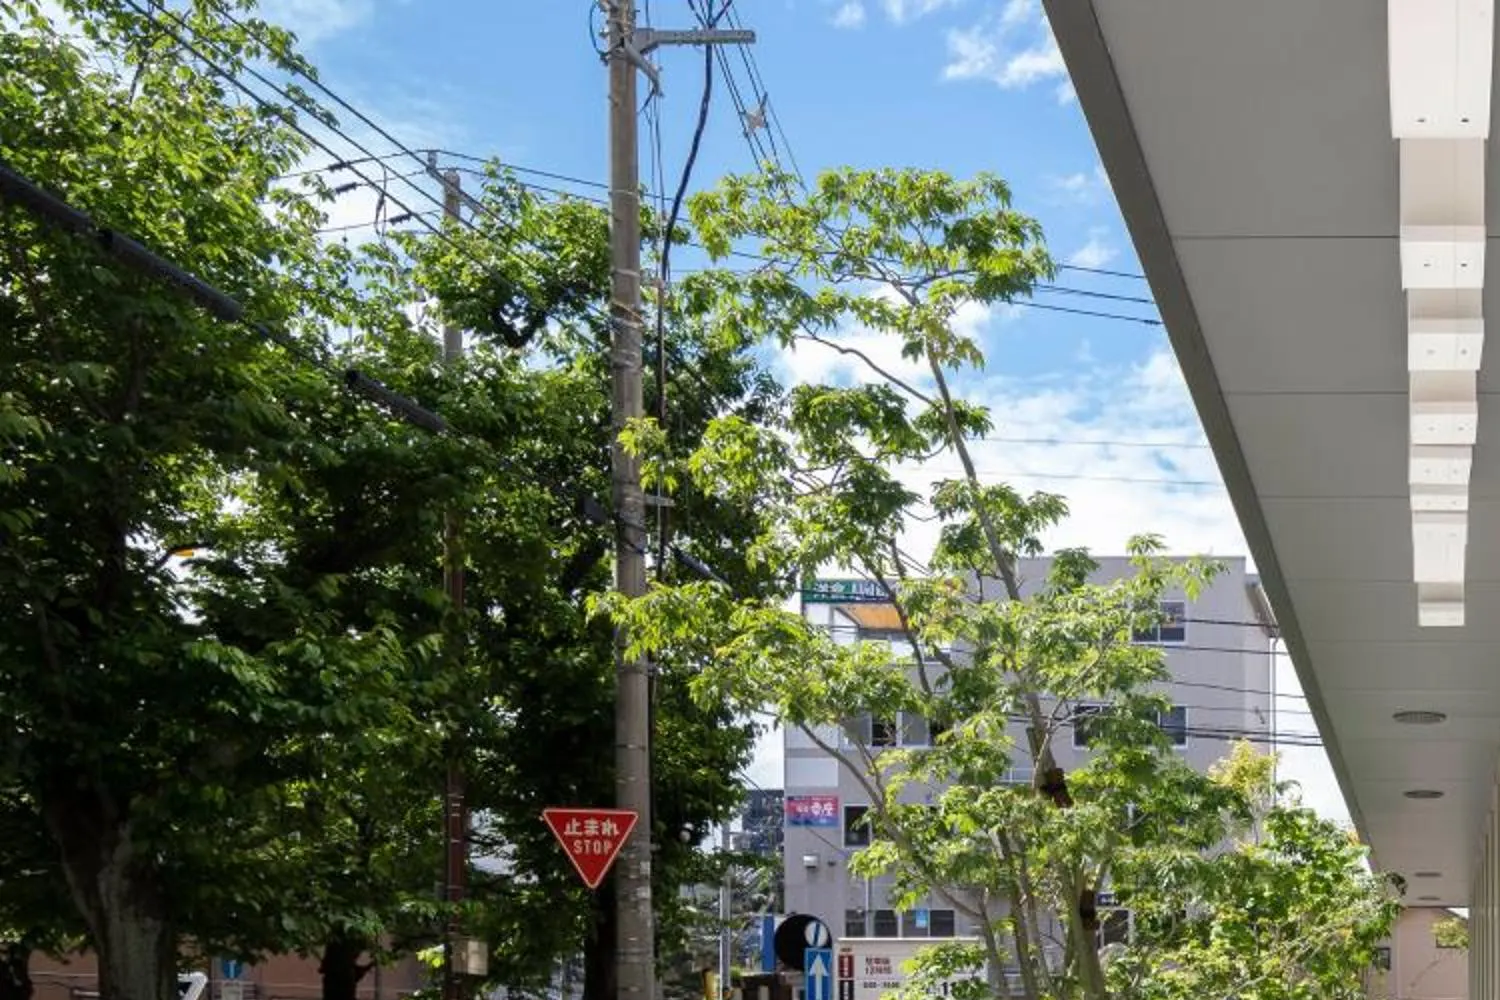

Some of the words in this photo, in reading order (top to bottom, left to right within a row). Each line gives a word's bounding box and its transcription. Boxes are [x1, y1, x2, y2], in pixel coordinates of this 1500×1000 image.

[563, 817, 620, 837] 止まれ
[573, 839, 613, 855] STOP
